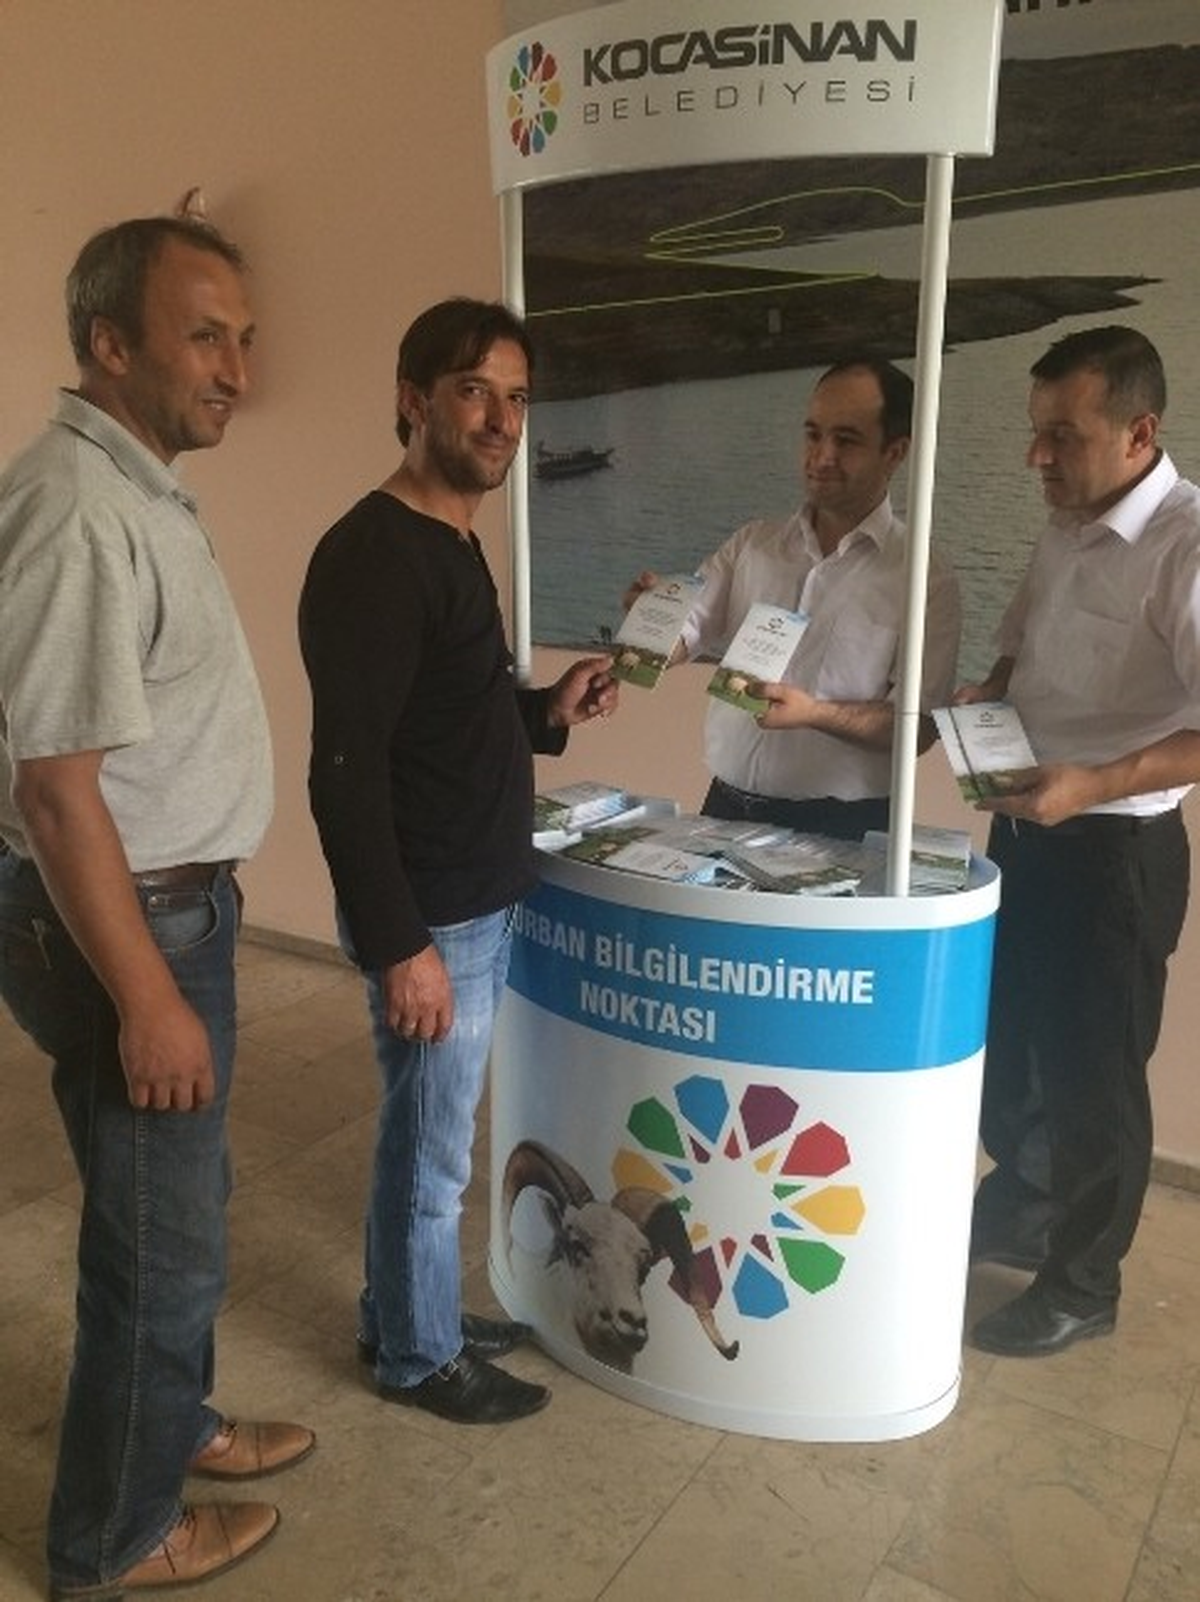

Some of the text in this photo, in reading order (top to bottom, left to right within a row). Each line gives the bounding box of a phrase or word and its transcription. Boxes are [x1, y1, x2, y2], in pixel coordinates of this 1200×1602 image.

[583, 76, 915, 124] BELEDİYESİ
[508, 903, 875, 1005] URBAN BİLGİLENDİRME
[580, 981, 716, 1043] NOKTASI
